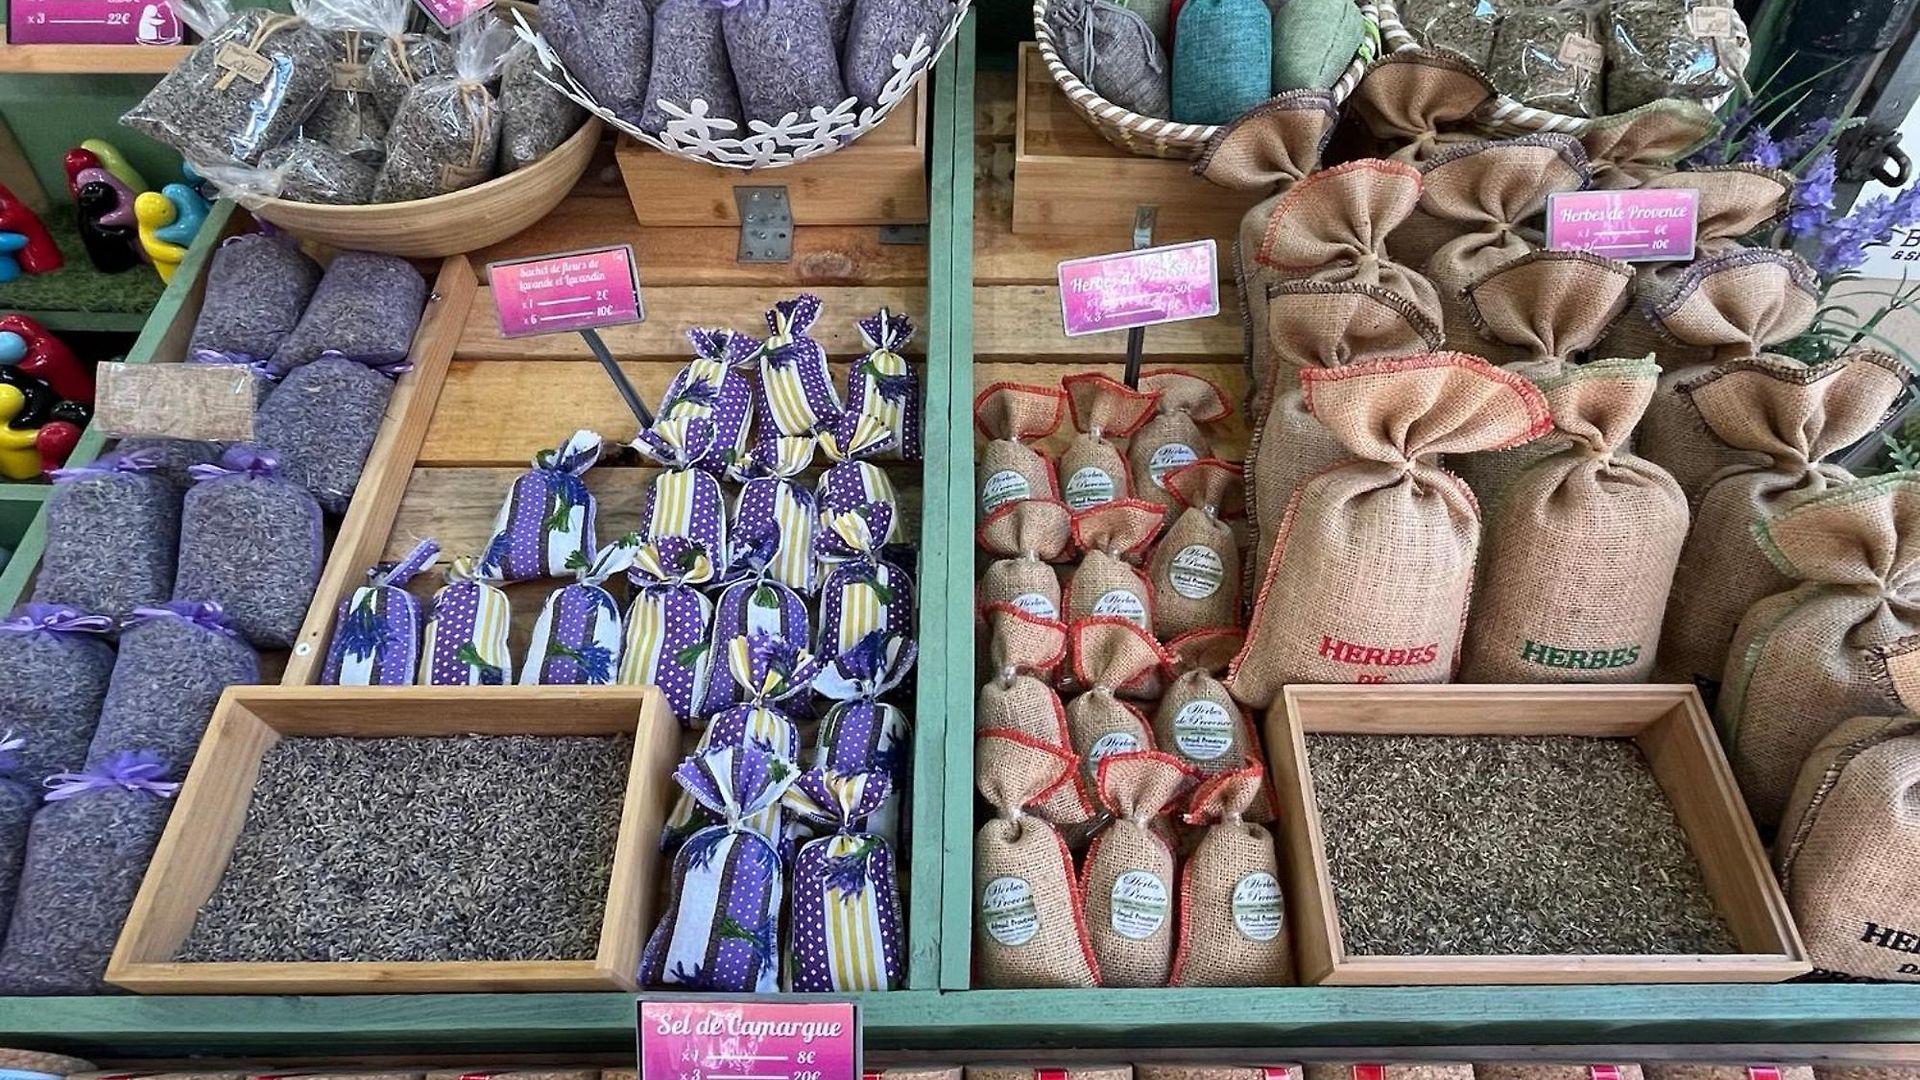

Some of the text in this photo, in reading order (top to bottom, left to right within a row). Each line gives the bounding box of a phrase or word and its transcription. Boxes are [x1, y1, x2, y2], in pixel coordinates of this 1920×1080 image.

[106, 13, 131, 25] 22€
[1560, 206, 1688, 222] Herbes de Provence
[1654, 225, 1668, 235] 6€
[1652, 239, 1670, 250] 10€
[519, 260, 600, 278] Sachet de fleurs de
[555, 276, 563, 286] et
[564, 272, 606, 287] Lavandin
[596, 290, 609, 301] 2€
[597, 305, 613, 317] 10€
[1318, 635, 1439, 667] HERBES
[1521, 639, 1641, 670] HERBES
[1186, 704, 1222, 716] Herbes
[1188, 714, 1231, 727] Provence
[1101, 737, 1137, 748] Herbes
[987, 880, 1025, 898] Herbes
[1123, 874, 1160, 890] Herbes
[1244, 879, 1278, 890] Herbes
[1123, 886, 1167, 902] Provence
[657, 1014, 842, 1043] Sel de Camargue
[796, 1050, 817, 1064] 8€
